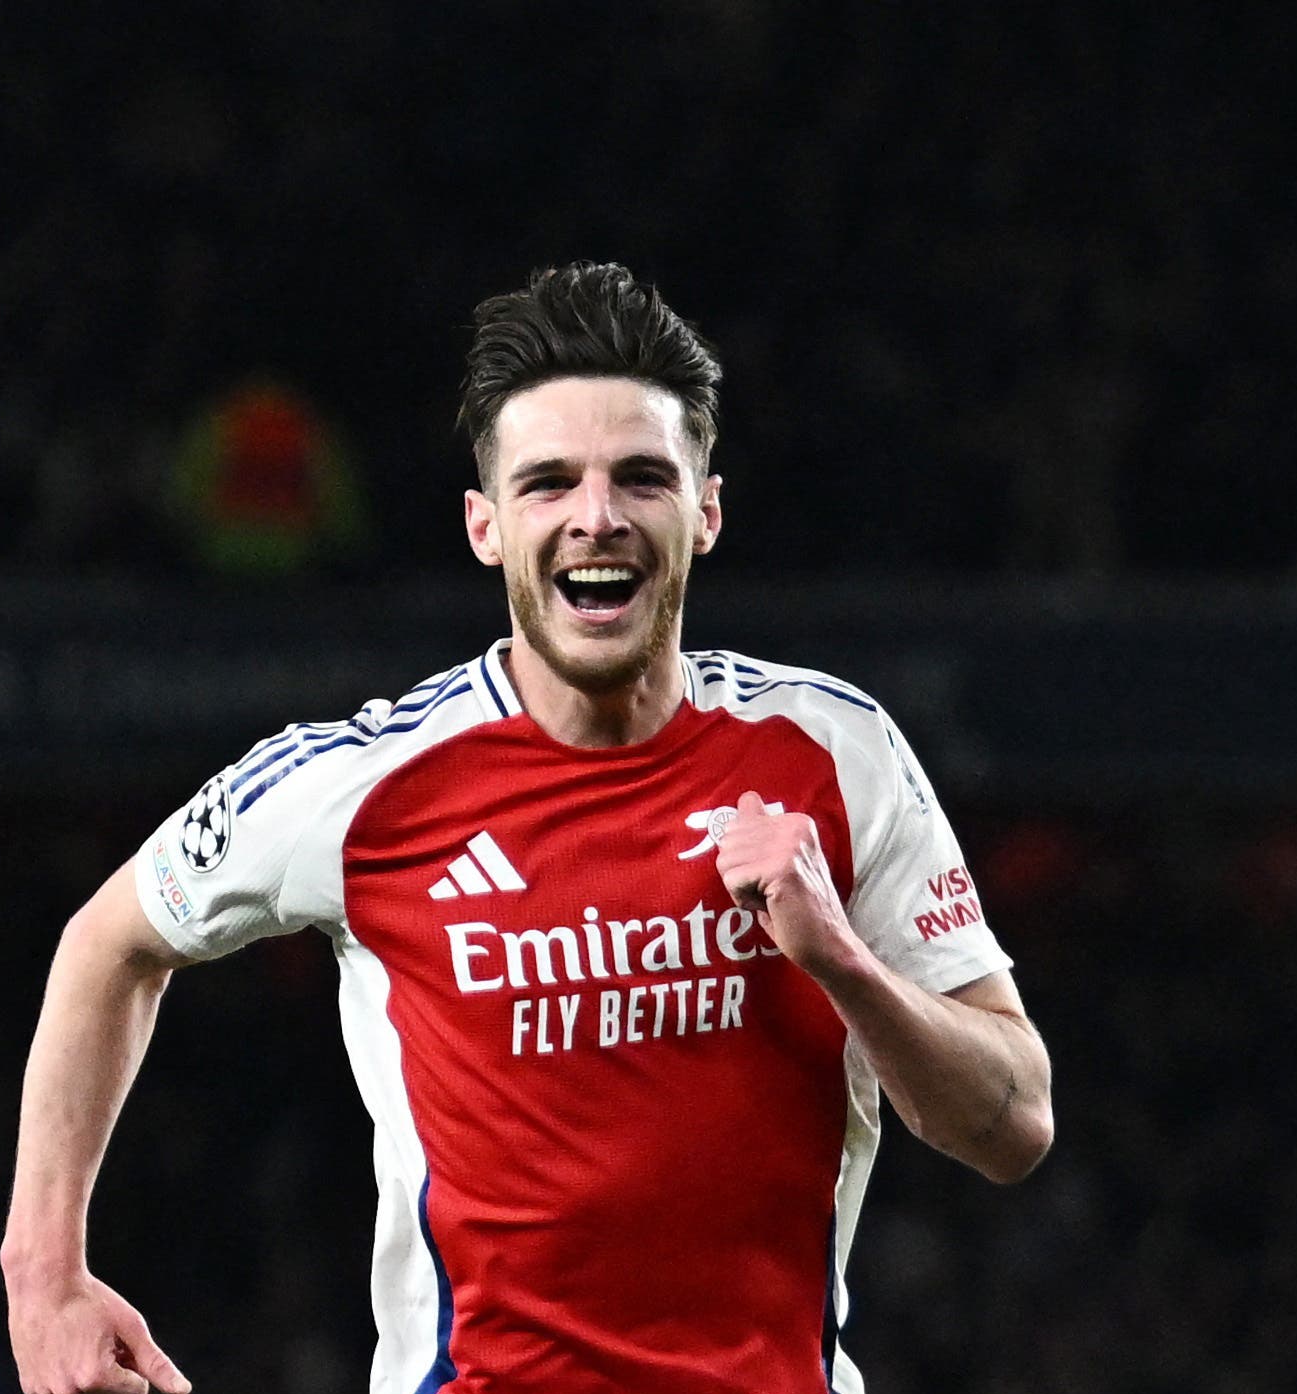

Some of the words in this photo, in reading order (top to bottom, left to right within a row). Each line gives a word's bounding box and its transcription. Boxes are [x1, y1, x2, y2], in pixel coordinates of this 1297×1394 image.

[444, 899, 782, 993] Emirate
[512, 994, 581, 1055] FLY
[599, 975, 746, 1048] BETTER
